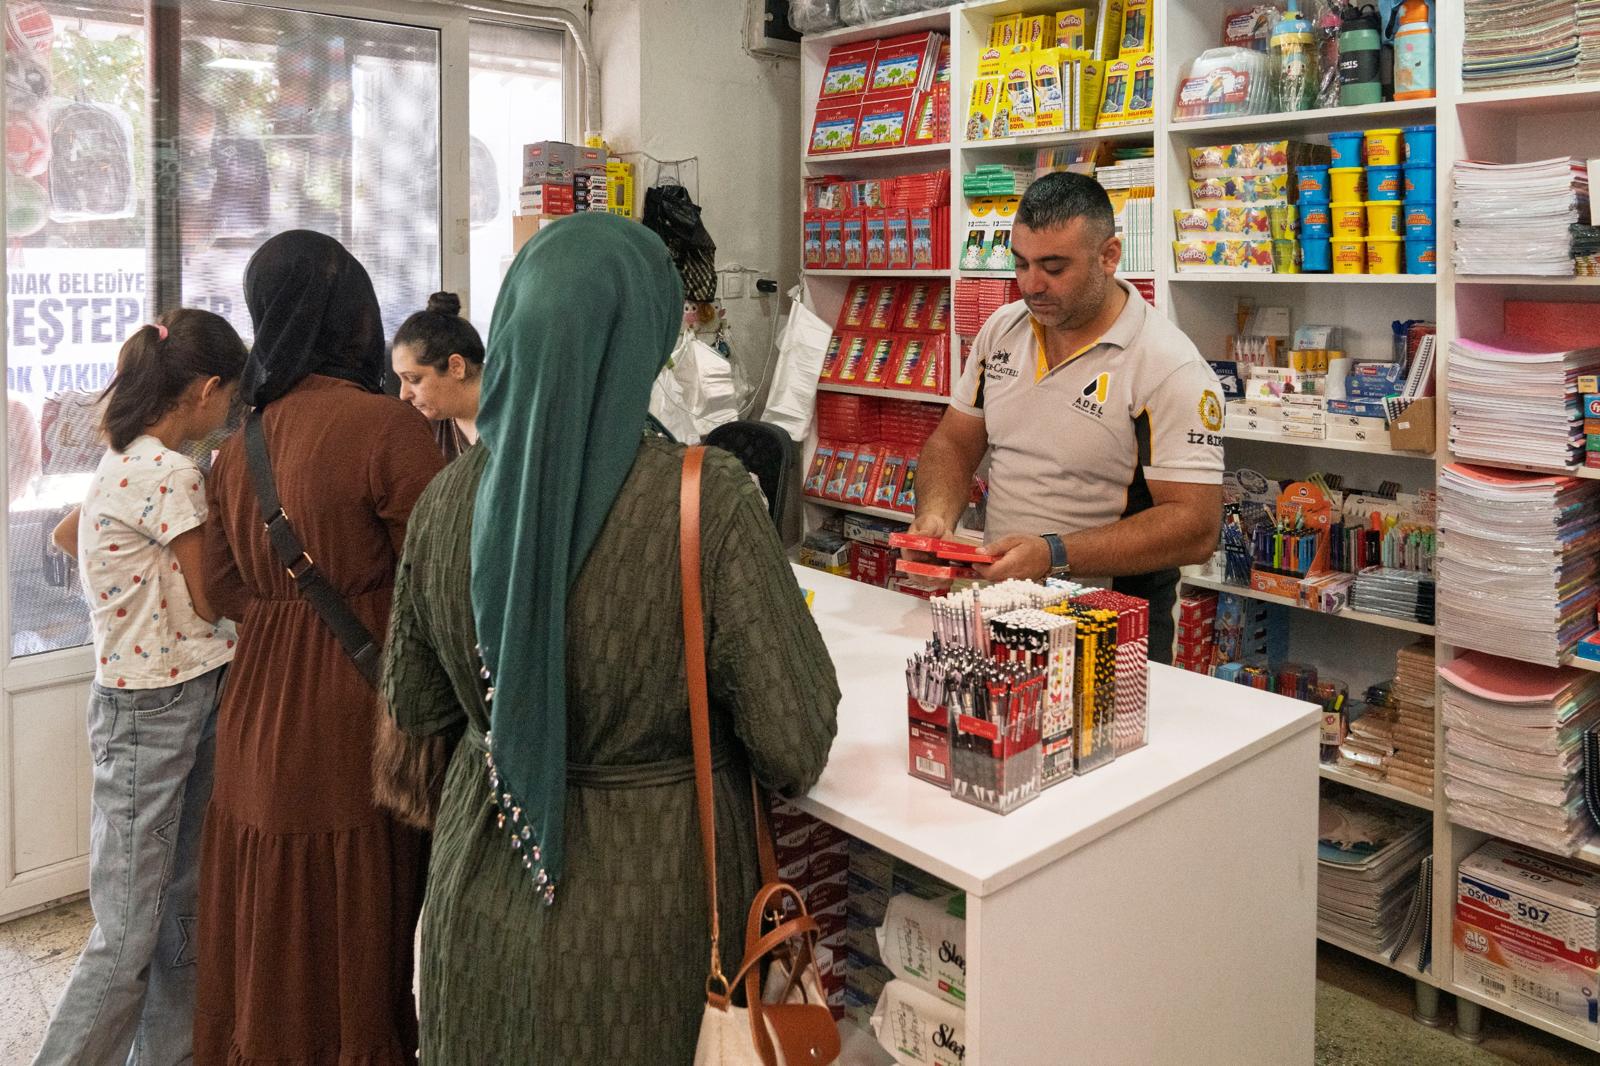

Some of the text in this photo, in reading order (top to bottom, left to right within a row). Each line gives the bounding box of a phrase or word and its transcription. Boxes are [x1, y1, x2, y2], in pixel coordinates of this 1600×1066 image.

[7, 273, 51, 295] NAK
[1075, 396, 1104, 416] ADEL
[1517, 857, 1576, 880] OSAKA
[1518, 870, 1554, 884] 507
[1467, 887, 1503, 908] OSAKA
[1517, 901, 1550, 923] 507
